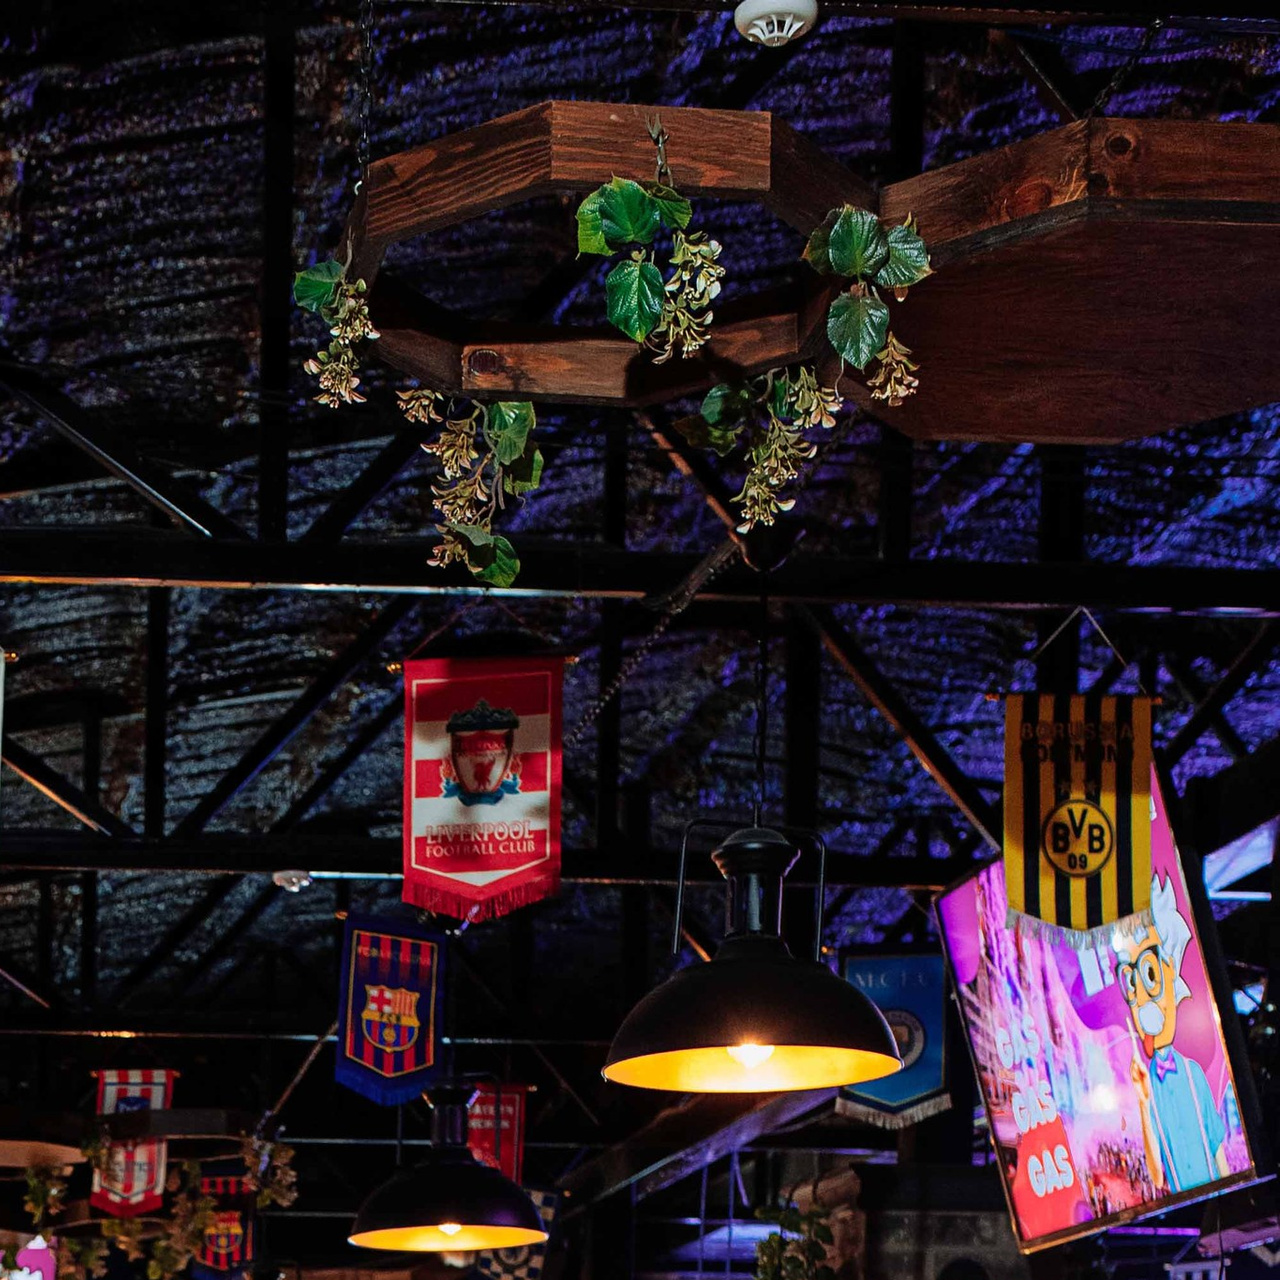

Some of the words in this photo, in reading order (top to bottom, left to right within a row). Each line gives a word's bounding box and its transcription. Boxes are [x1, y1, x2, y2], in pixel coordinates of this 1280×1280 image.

[426, 820, 534, 844] LIVERPOOL
[426, 843, 497, 858] FOOTBALL
[499, 840, 535, 855] CLUB
[1068, 854, 1088, 870] 09
[996, 1014, 1040, 1068] GAS
[1012, 1080, 1057, 1133] GAS
[1027, 1145, 1074, 1198] GAS
